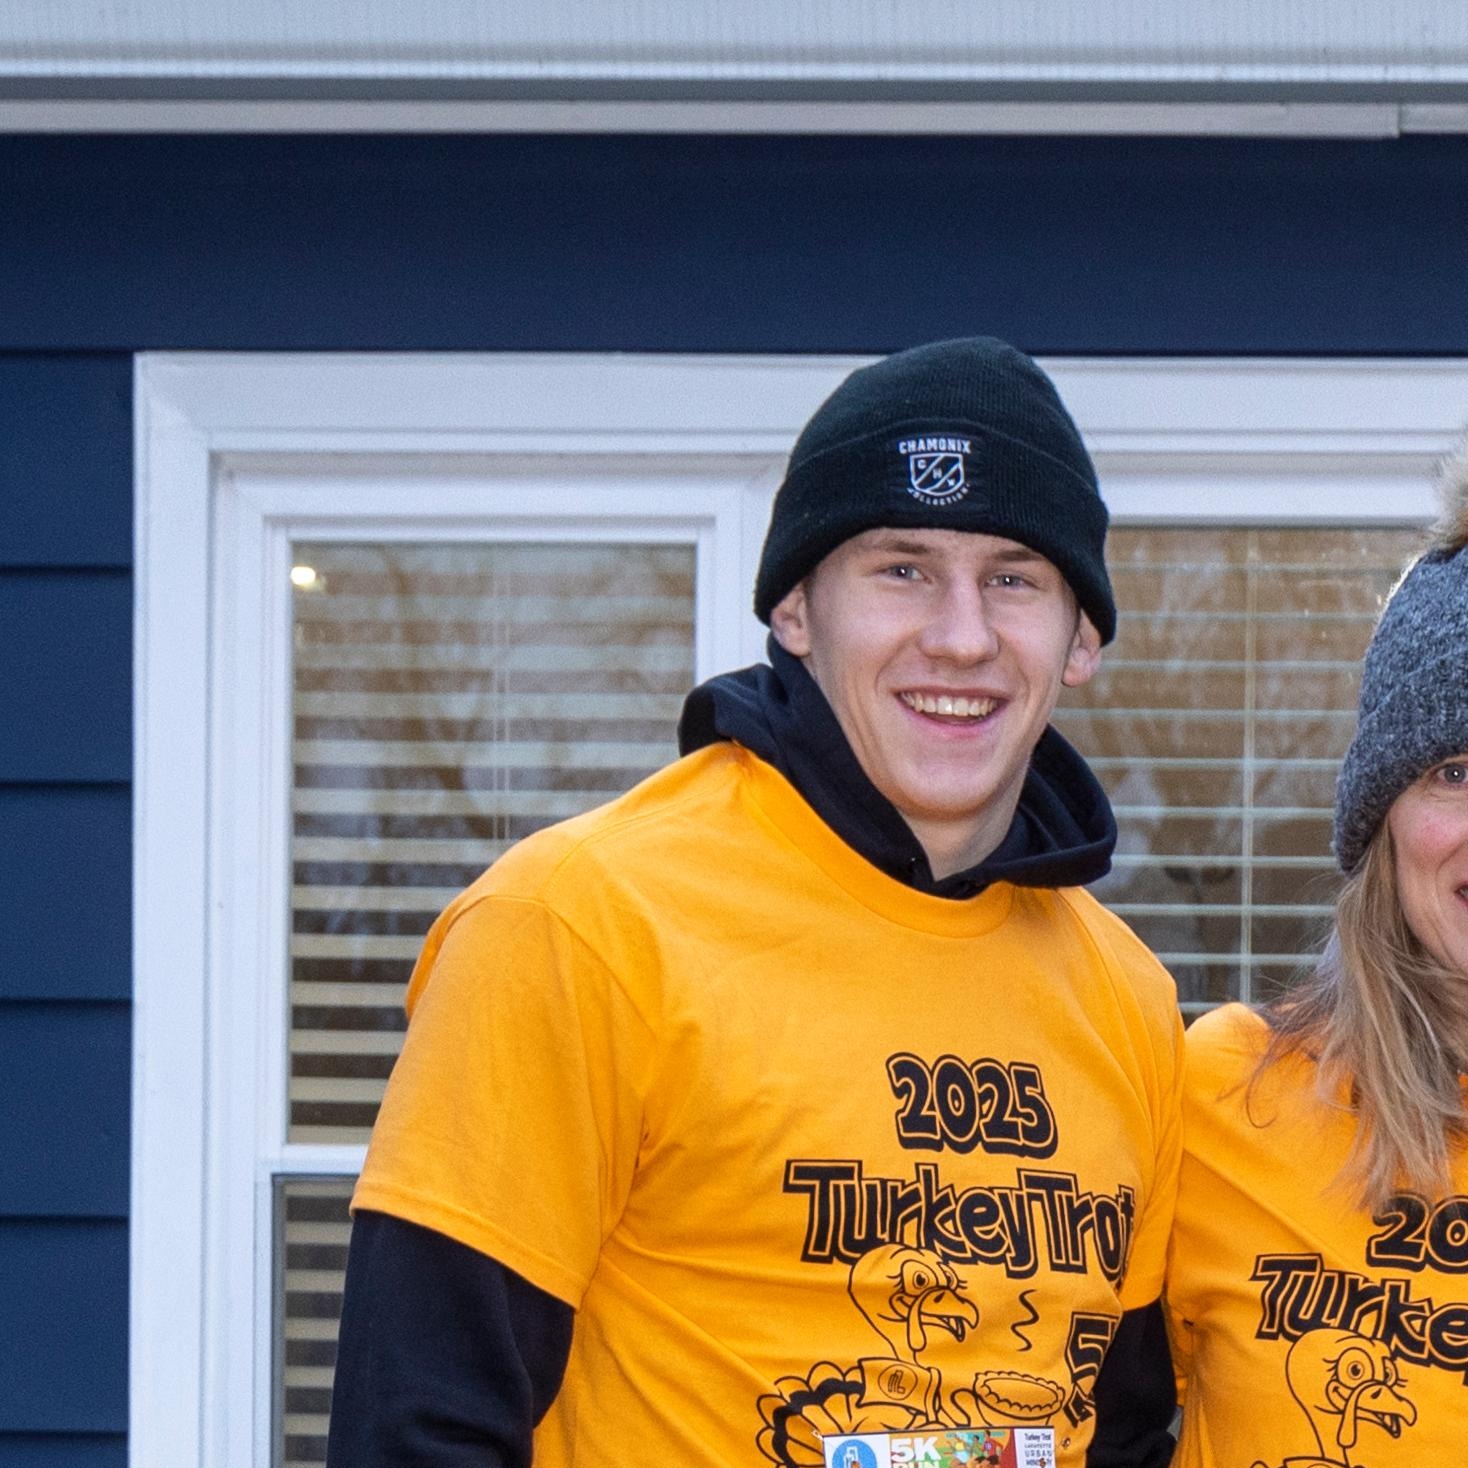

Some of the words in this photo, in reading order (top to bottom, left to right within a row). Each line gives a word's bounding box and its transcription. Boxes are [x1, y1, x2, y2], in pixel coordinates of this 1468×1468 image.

[899, 438, 971, 454] CHAMONIX
[886, 1052, 1058, 1159] 2025
[891, 1436, 942, 1462] 5K
